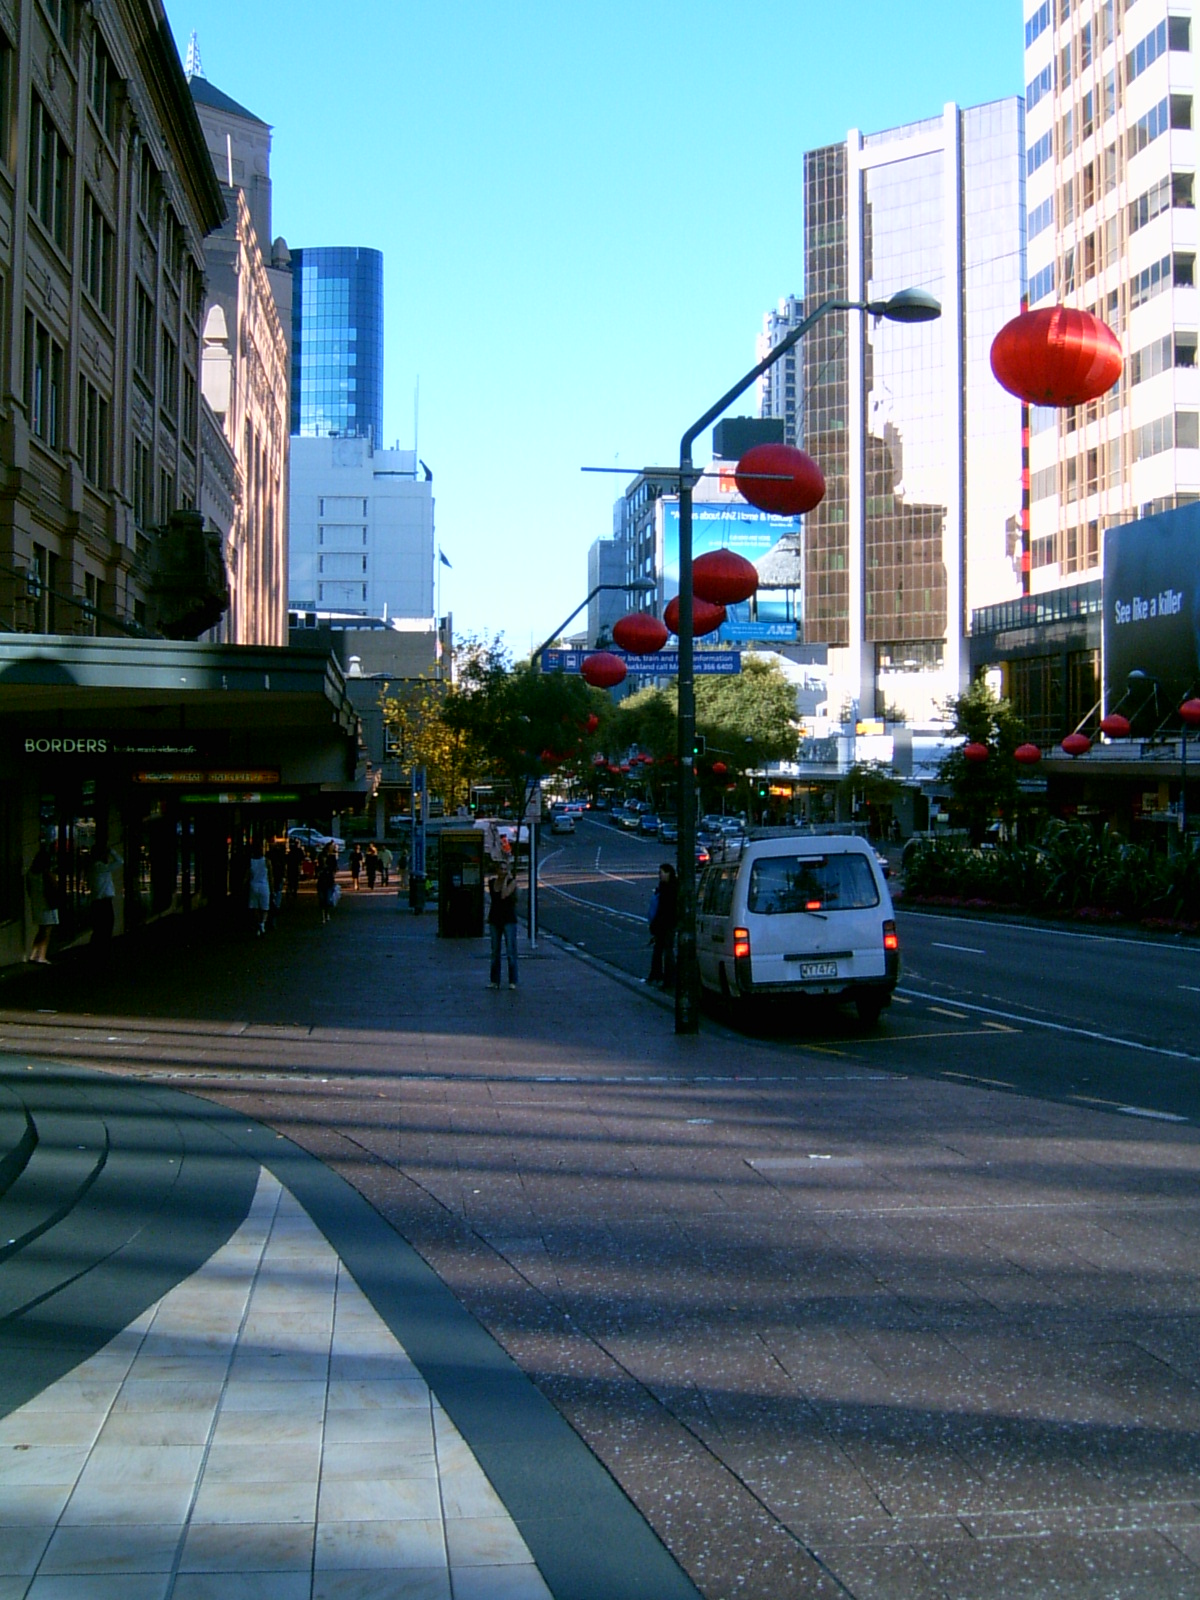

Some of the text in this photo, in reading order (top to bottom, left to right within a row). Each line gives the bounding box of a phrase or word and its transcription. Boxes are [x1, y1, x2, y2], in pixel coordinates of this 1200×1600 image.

[721, 511, 736, 520] ANZ
[1115, 589, 1182, 624] See like a killer
[766, 625, 794, 635] ANZ
[24, 738, 107, 753] BORDERS
